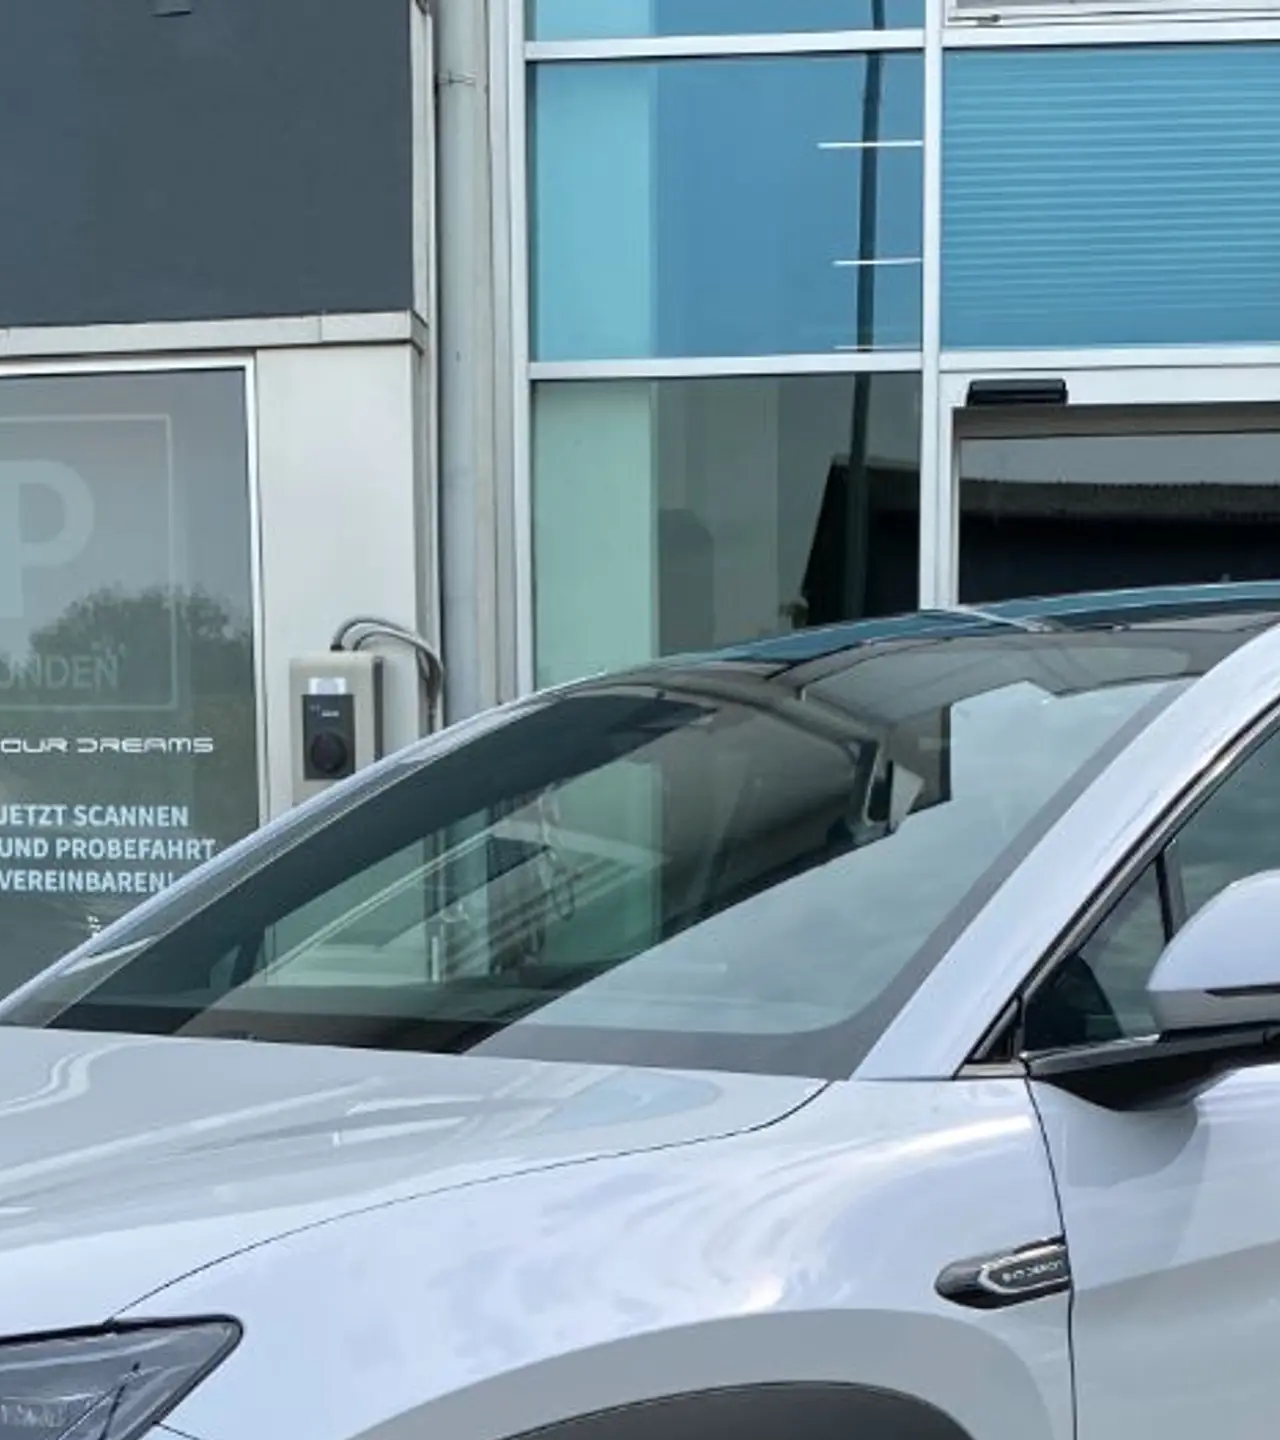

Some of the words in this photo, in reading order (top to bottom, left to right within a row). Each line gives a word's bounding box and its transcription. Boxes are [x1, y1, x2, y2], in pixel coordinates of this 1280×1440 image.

[76, 737, 214, 754] DREAMS
[73, 805, 190, 828] SCANNEN
[55, 837, 217, 861] PROBEFAHRT
